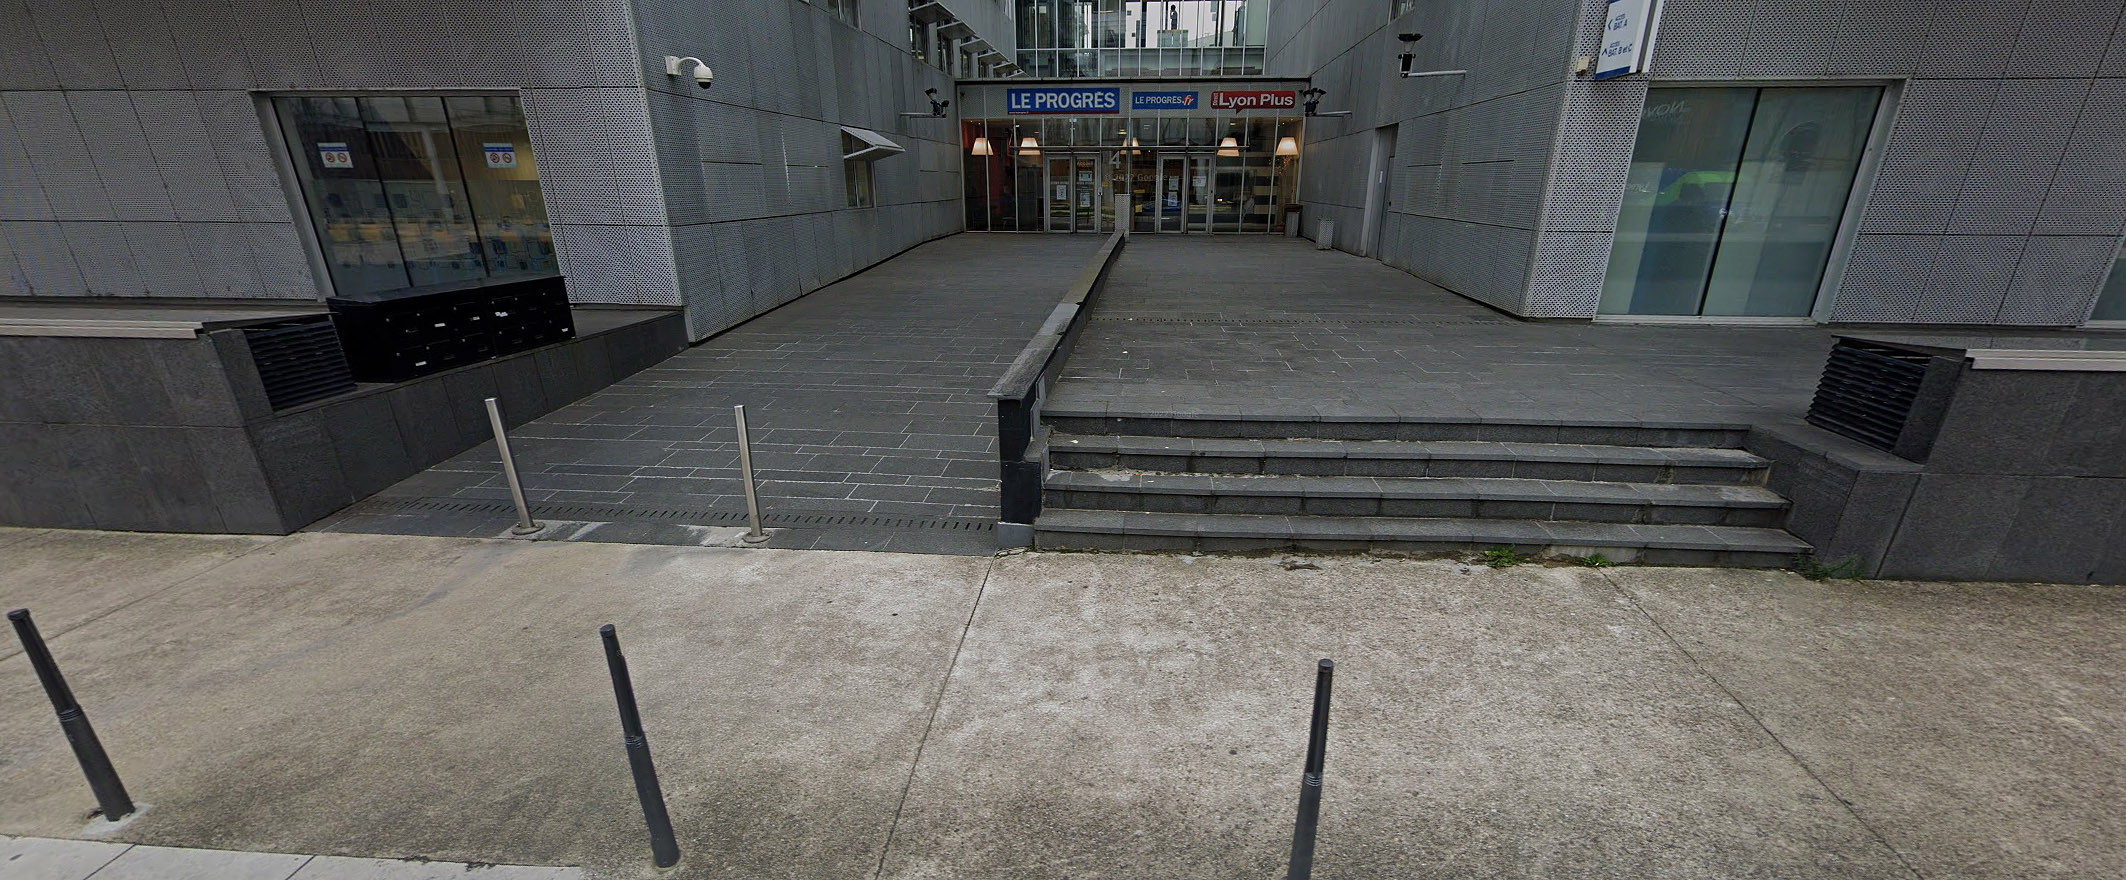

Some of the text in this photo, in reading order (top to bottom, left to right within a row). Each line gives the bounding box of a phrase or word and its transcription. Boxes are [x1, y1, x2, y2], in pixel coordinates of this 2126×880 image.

[1011, 91, 1116, 109] LE PROGRÈS
[1135, 96, 1144, 104] LE
[1219, 92, 1293, 108] Lyon Plus
[1109, 151, 1121, 169] 4
